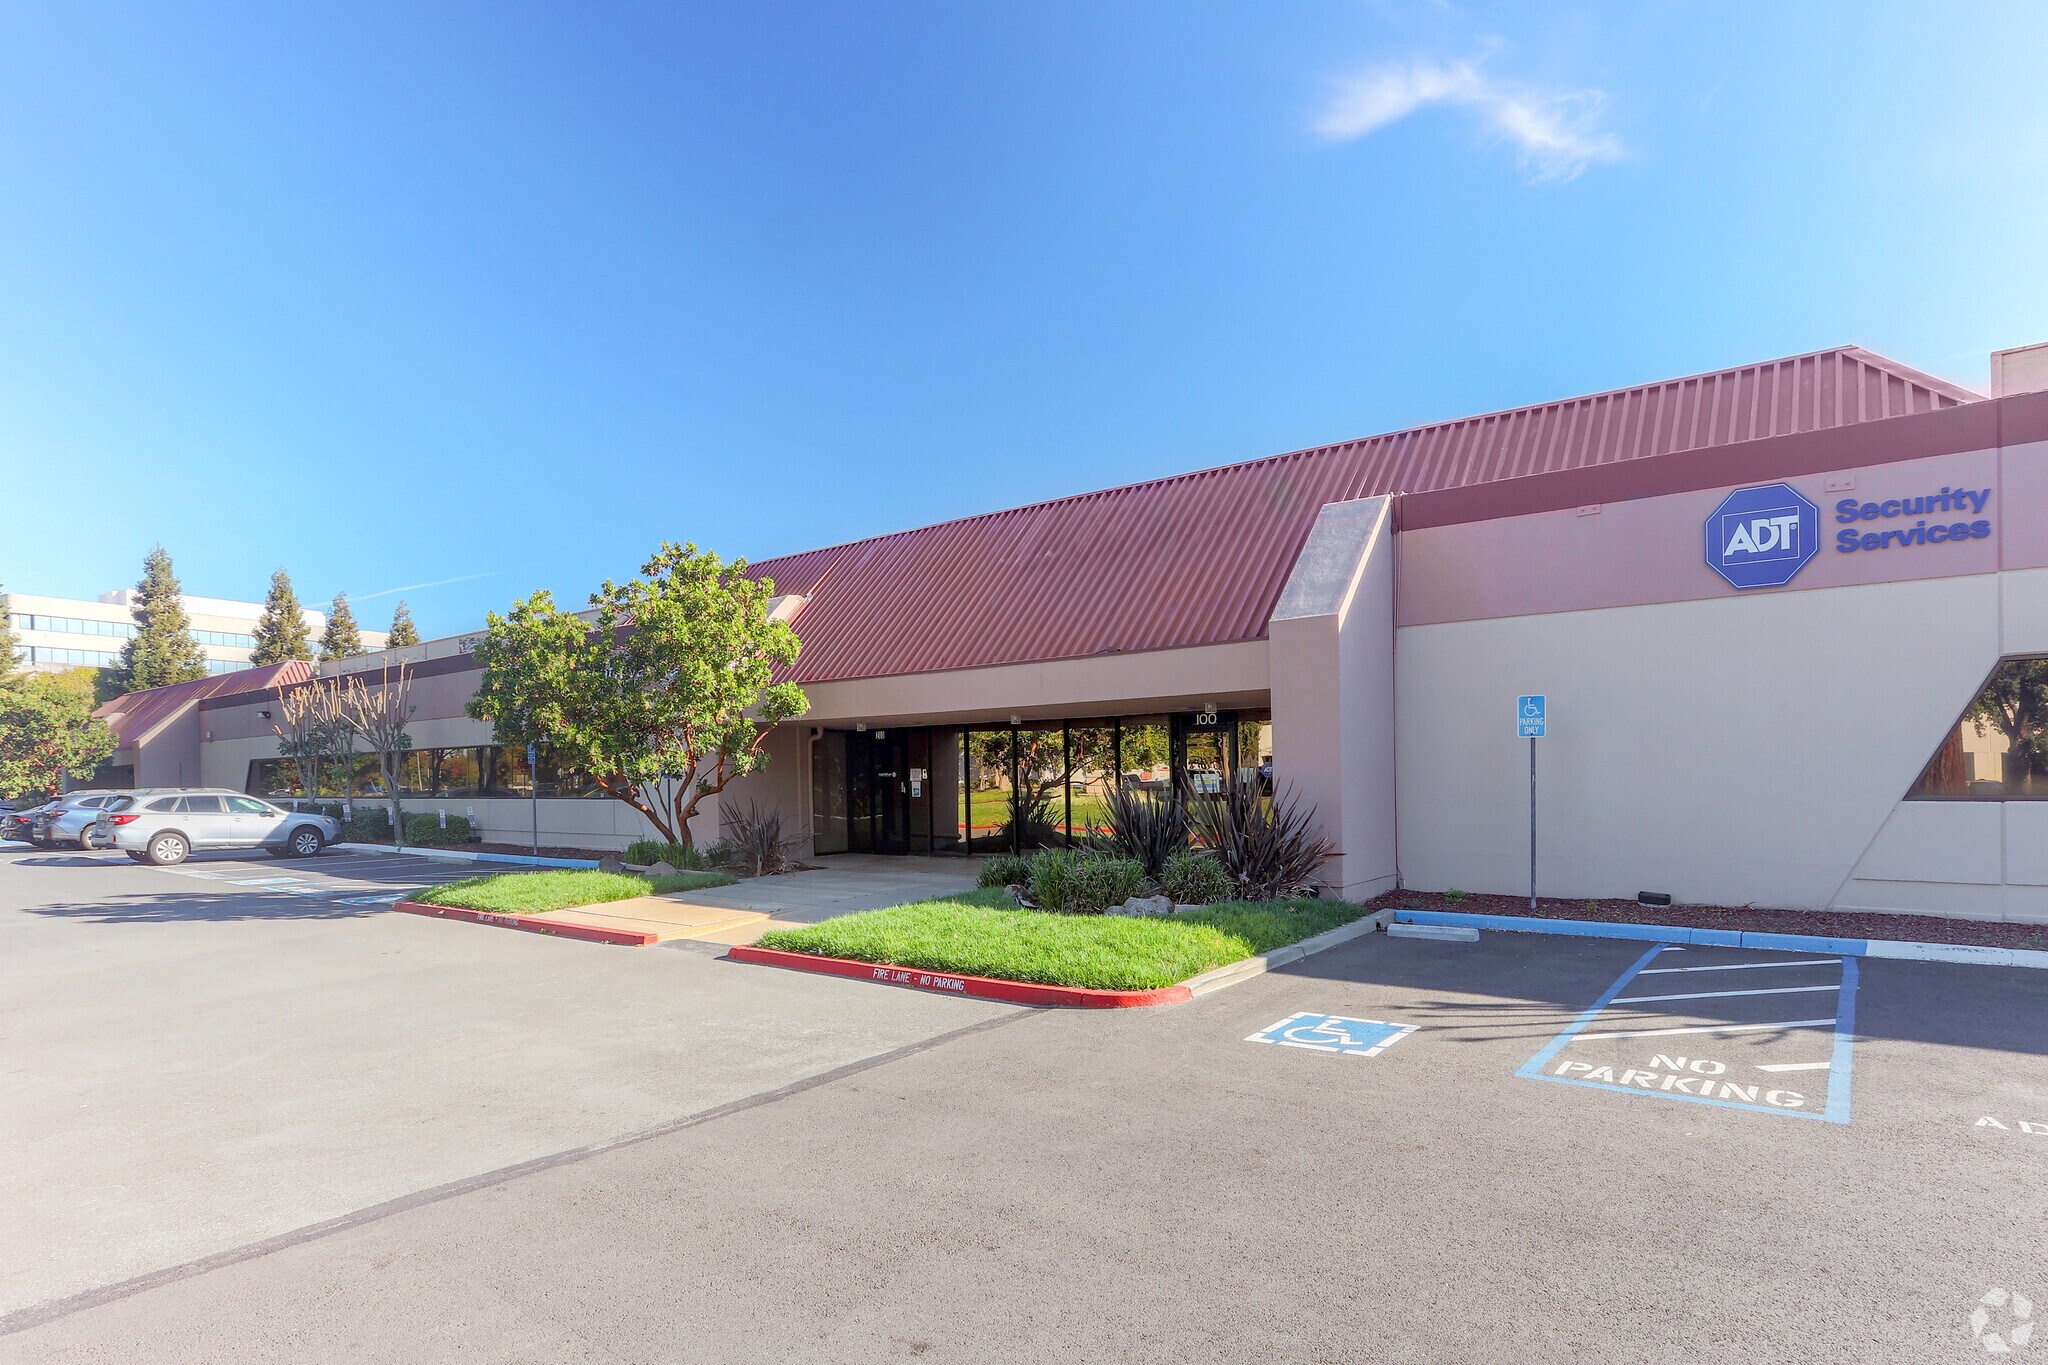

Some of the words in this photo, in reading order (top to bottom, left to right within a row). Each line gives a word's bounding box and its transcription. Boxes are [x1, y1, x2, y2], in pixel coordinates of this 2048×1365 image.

[1835, 487, 1991, 523] Security
[1724, 515, 1799, 556] ADT
[1836, 520, 1991, 553] Services
[1196, 714, 1217, 725] 100
[1519, 717, 1544, 726] PARKING
[1524, 726, 1539, 734] ONLY
[873, 968, 889, 979] FIRE
[892, 971, 911, 982] LANE
[920, 974, 931, 985] NO
[933, 977, 965, 990] PARKING
[1648, 1053, 1726, 1075] NO
[1553, 1060, 1806, 1107] PARKING
